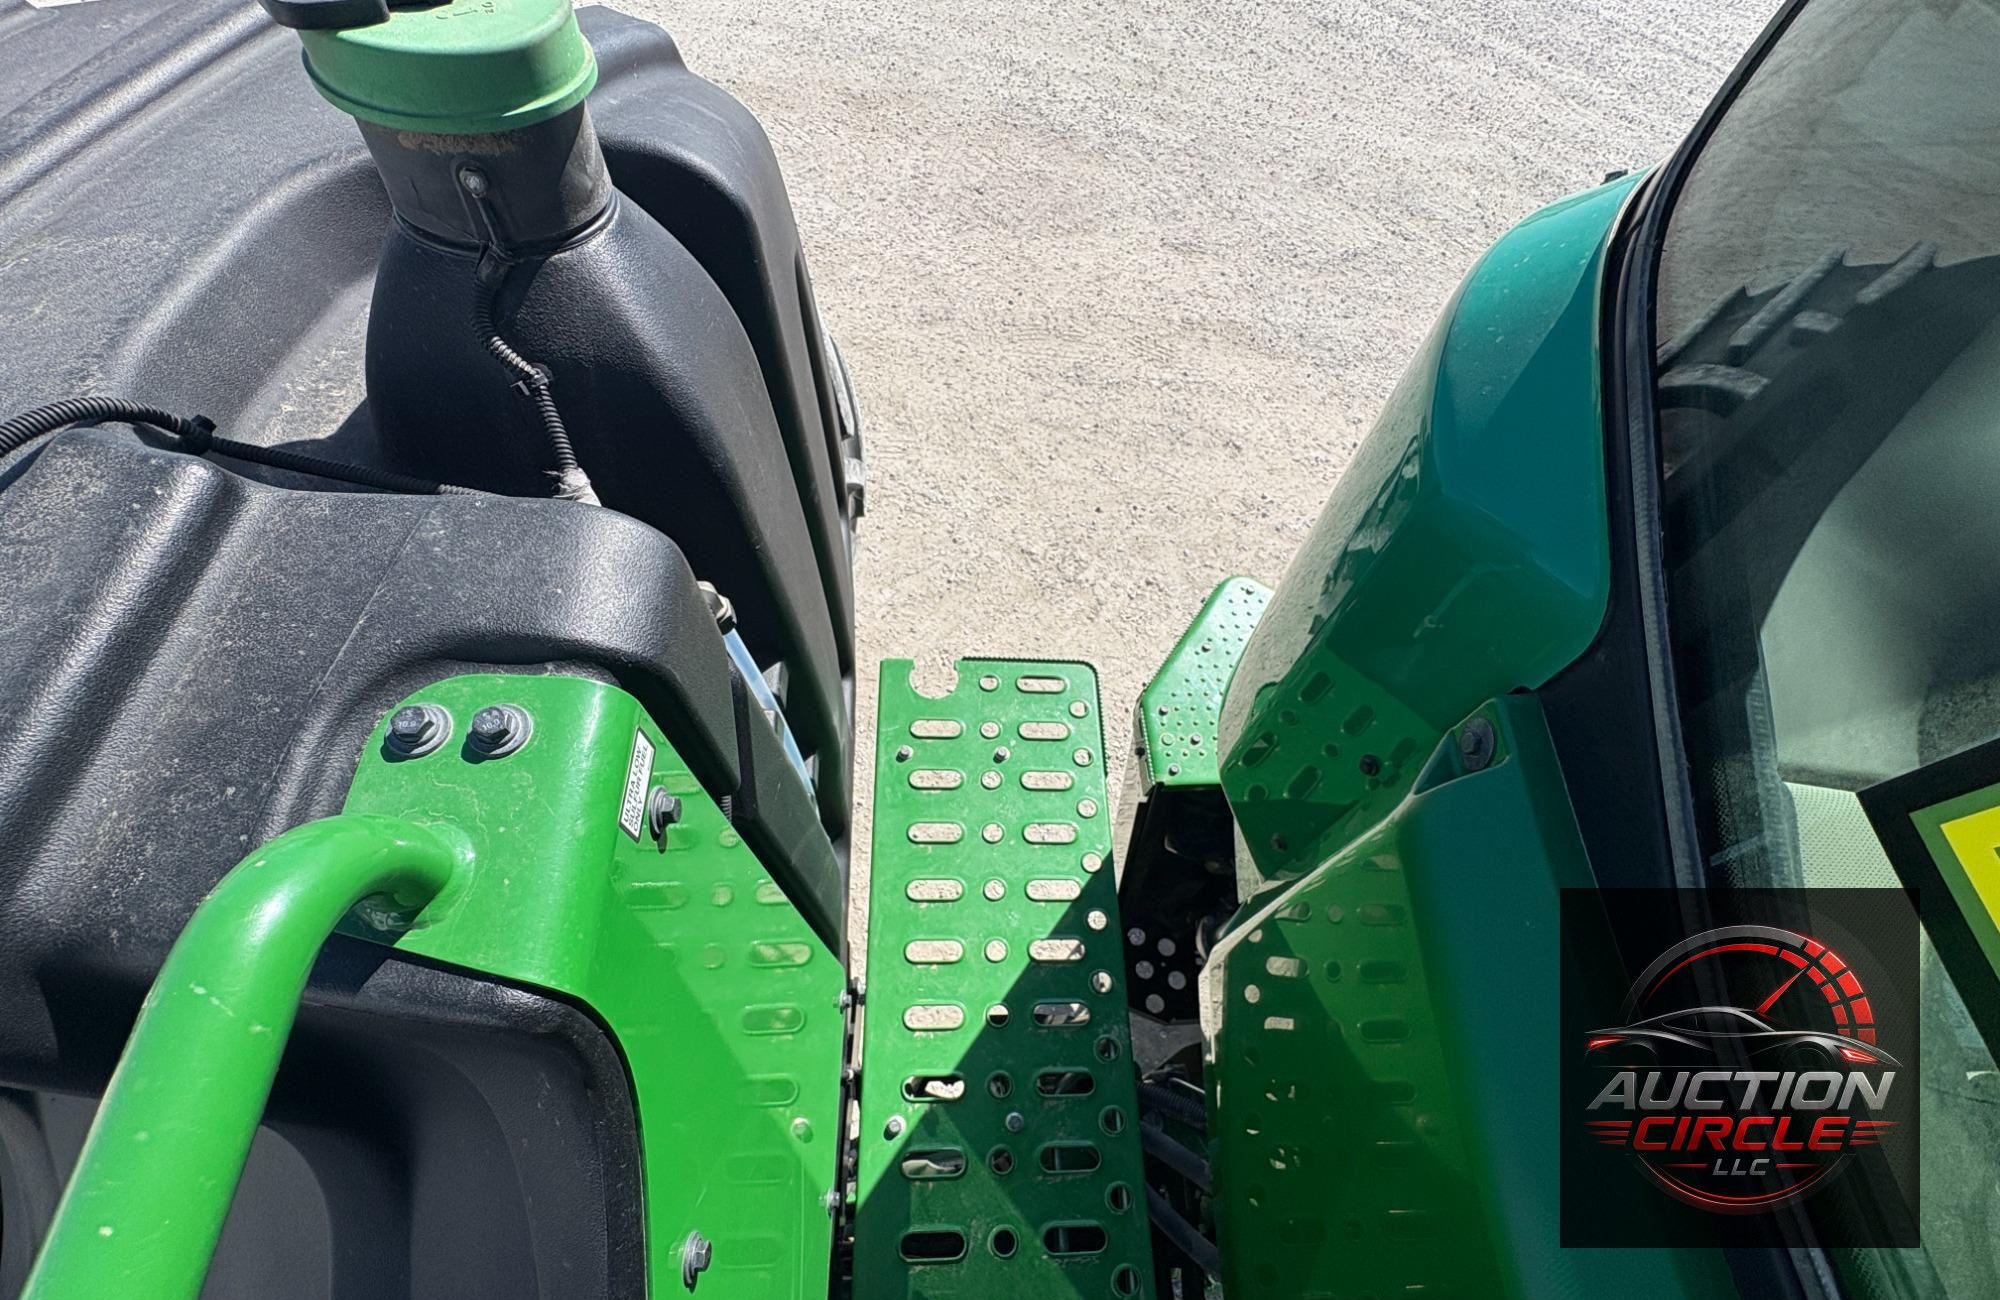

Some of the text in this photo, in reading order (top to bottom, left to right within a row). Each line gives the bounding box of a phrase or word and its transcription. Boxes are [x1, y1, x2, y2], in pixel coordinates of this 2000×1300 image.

[624, 748, 642, 822] ULTRA LOW
[628, 745, 648, 828] SULFUR FUEL
[633, 799, 643, 831] ONLY
